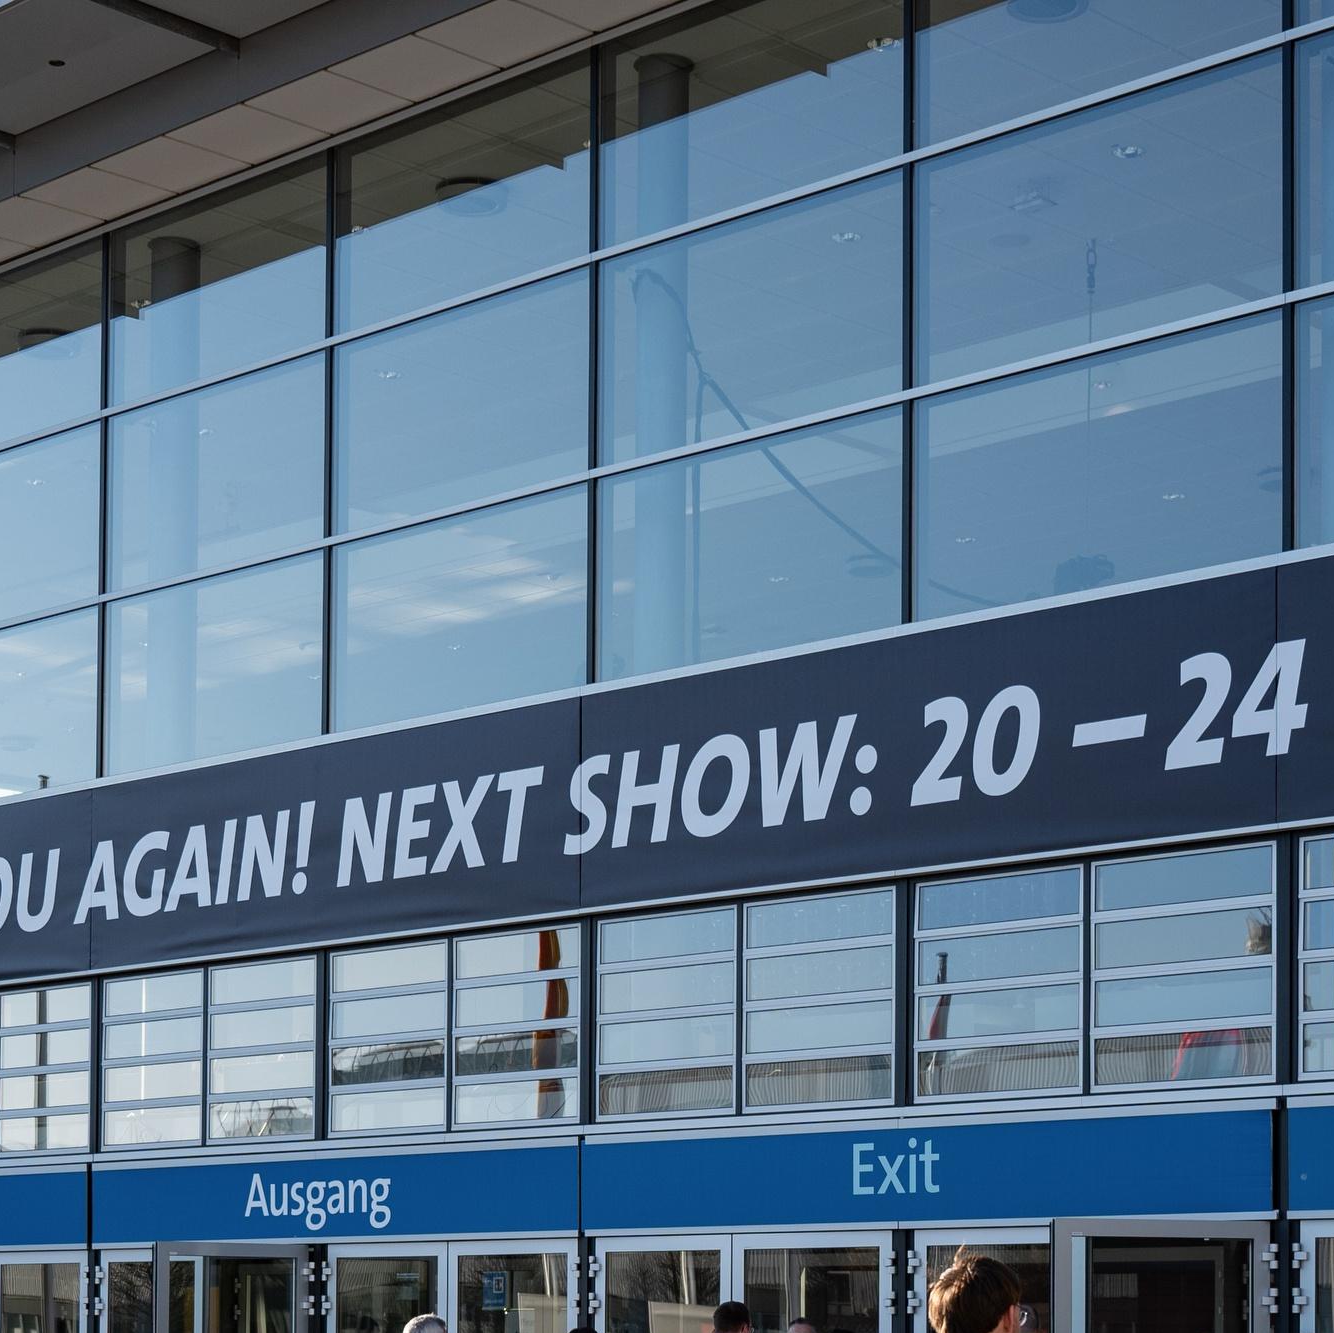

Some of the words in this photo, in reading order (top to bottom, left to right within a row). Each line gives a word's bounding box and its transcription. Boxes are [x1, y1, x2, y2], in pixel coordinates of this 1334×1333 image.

[73, 800, 315, 925] AGAIN!
[337, 765, 544, 887] NEXT
[563, 714, 877, 855] SHOW:
[910, 685, 1040, 806] 20
[1165, 639, 1308, 770] 24
[852, 1139, 940, 1195] Exit
[244, 1173, 392, 1231] Ausgang
